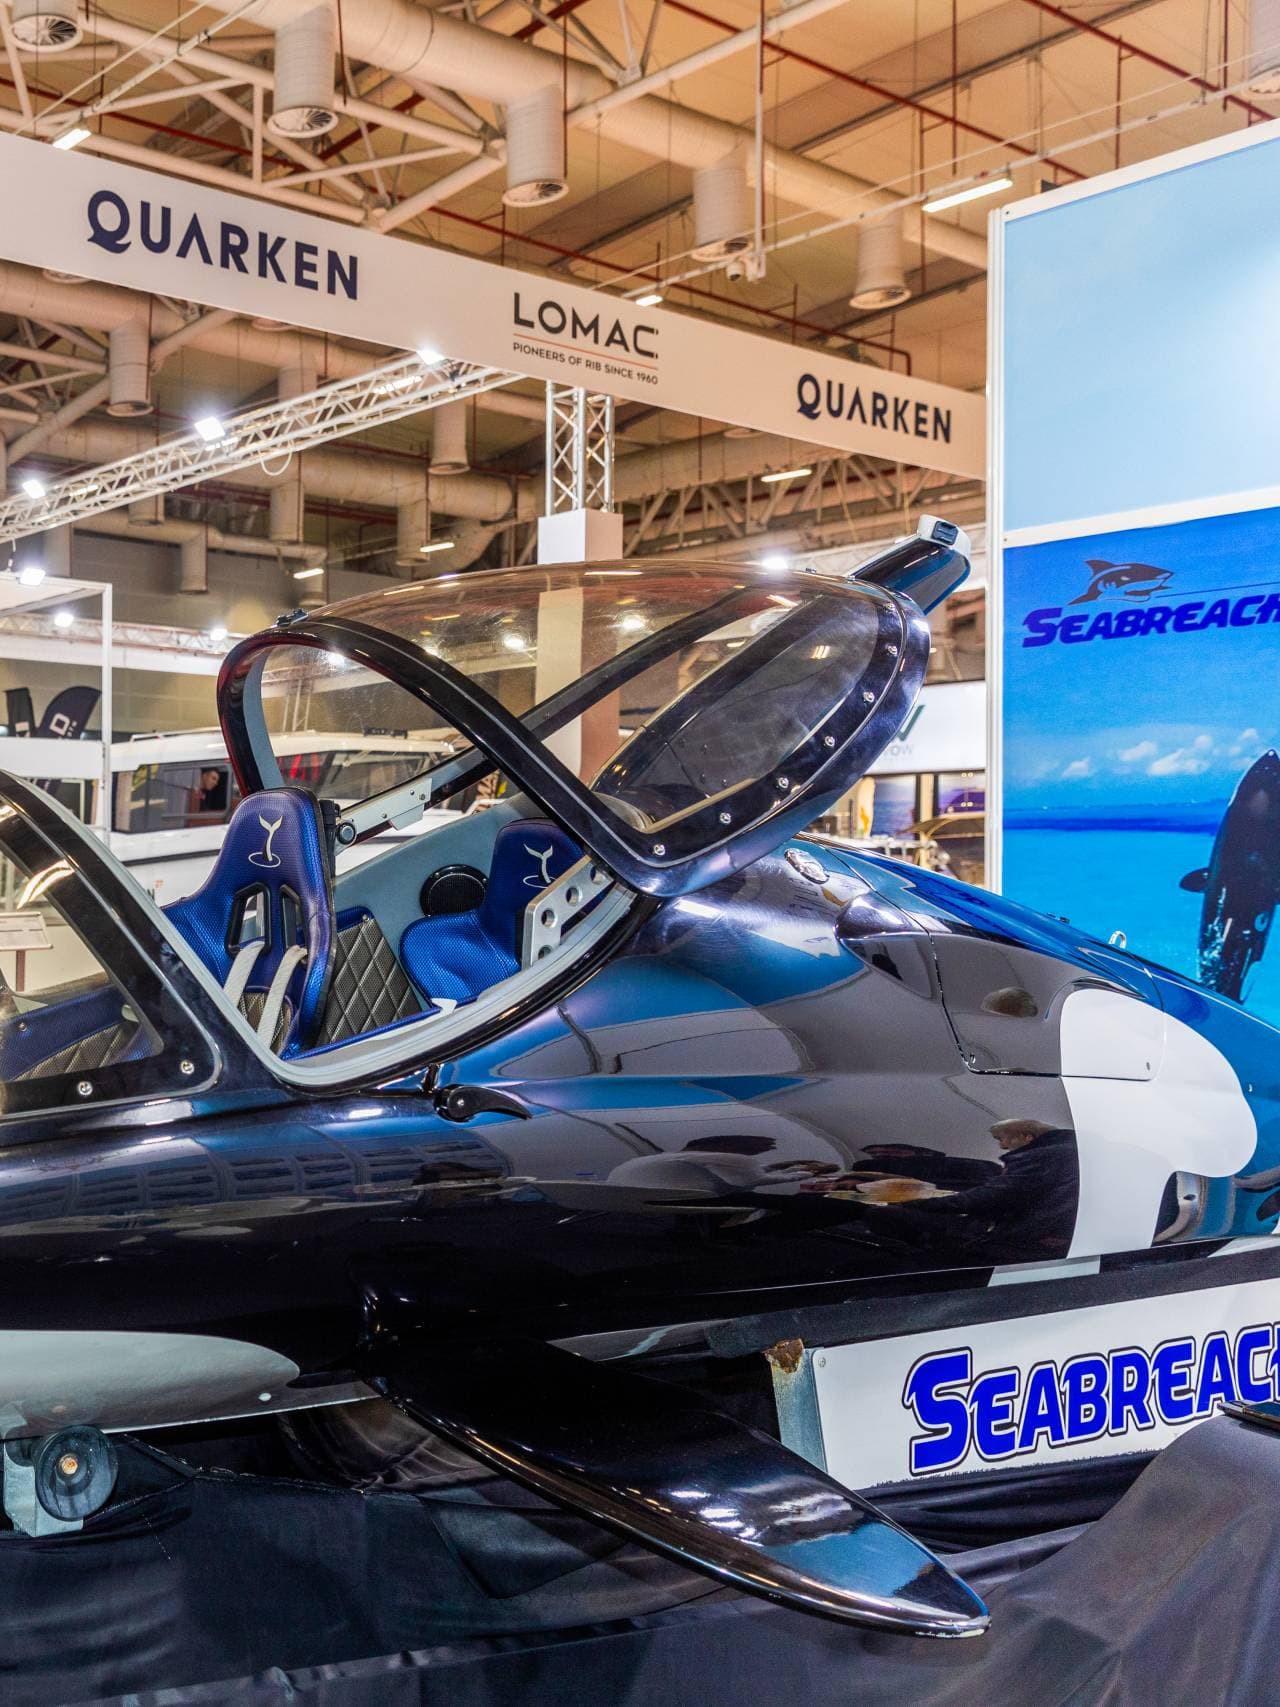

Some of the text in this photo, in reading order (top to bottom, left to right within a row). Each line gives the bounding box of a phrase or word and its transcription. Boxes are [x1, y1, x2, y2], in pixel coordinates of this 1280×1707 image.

[87, 189, 358, 301] QUARKEN
[513, 292, 659, 360] LOMAC
[513, 341, 658, 386] PIONEERS OF RIB SINCE 1960
[797, 373, 951, 444] QUARKEN
[902, 1322, 1280, 1477] SEABREAC
